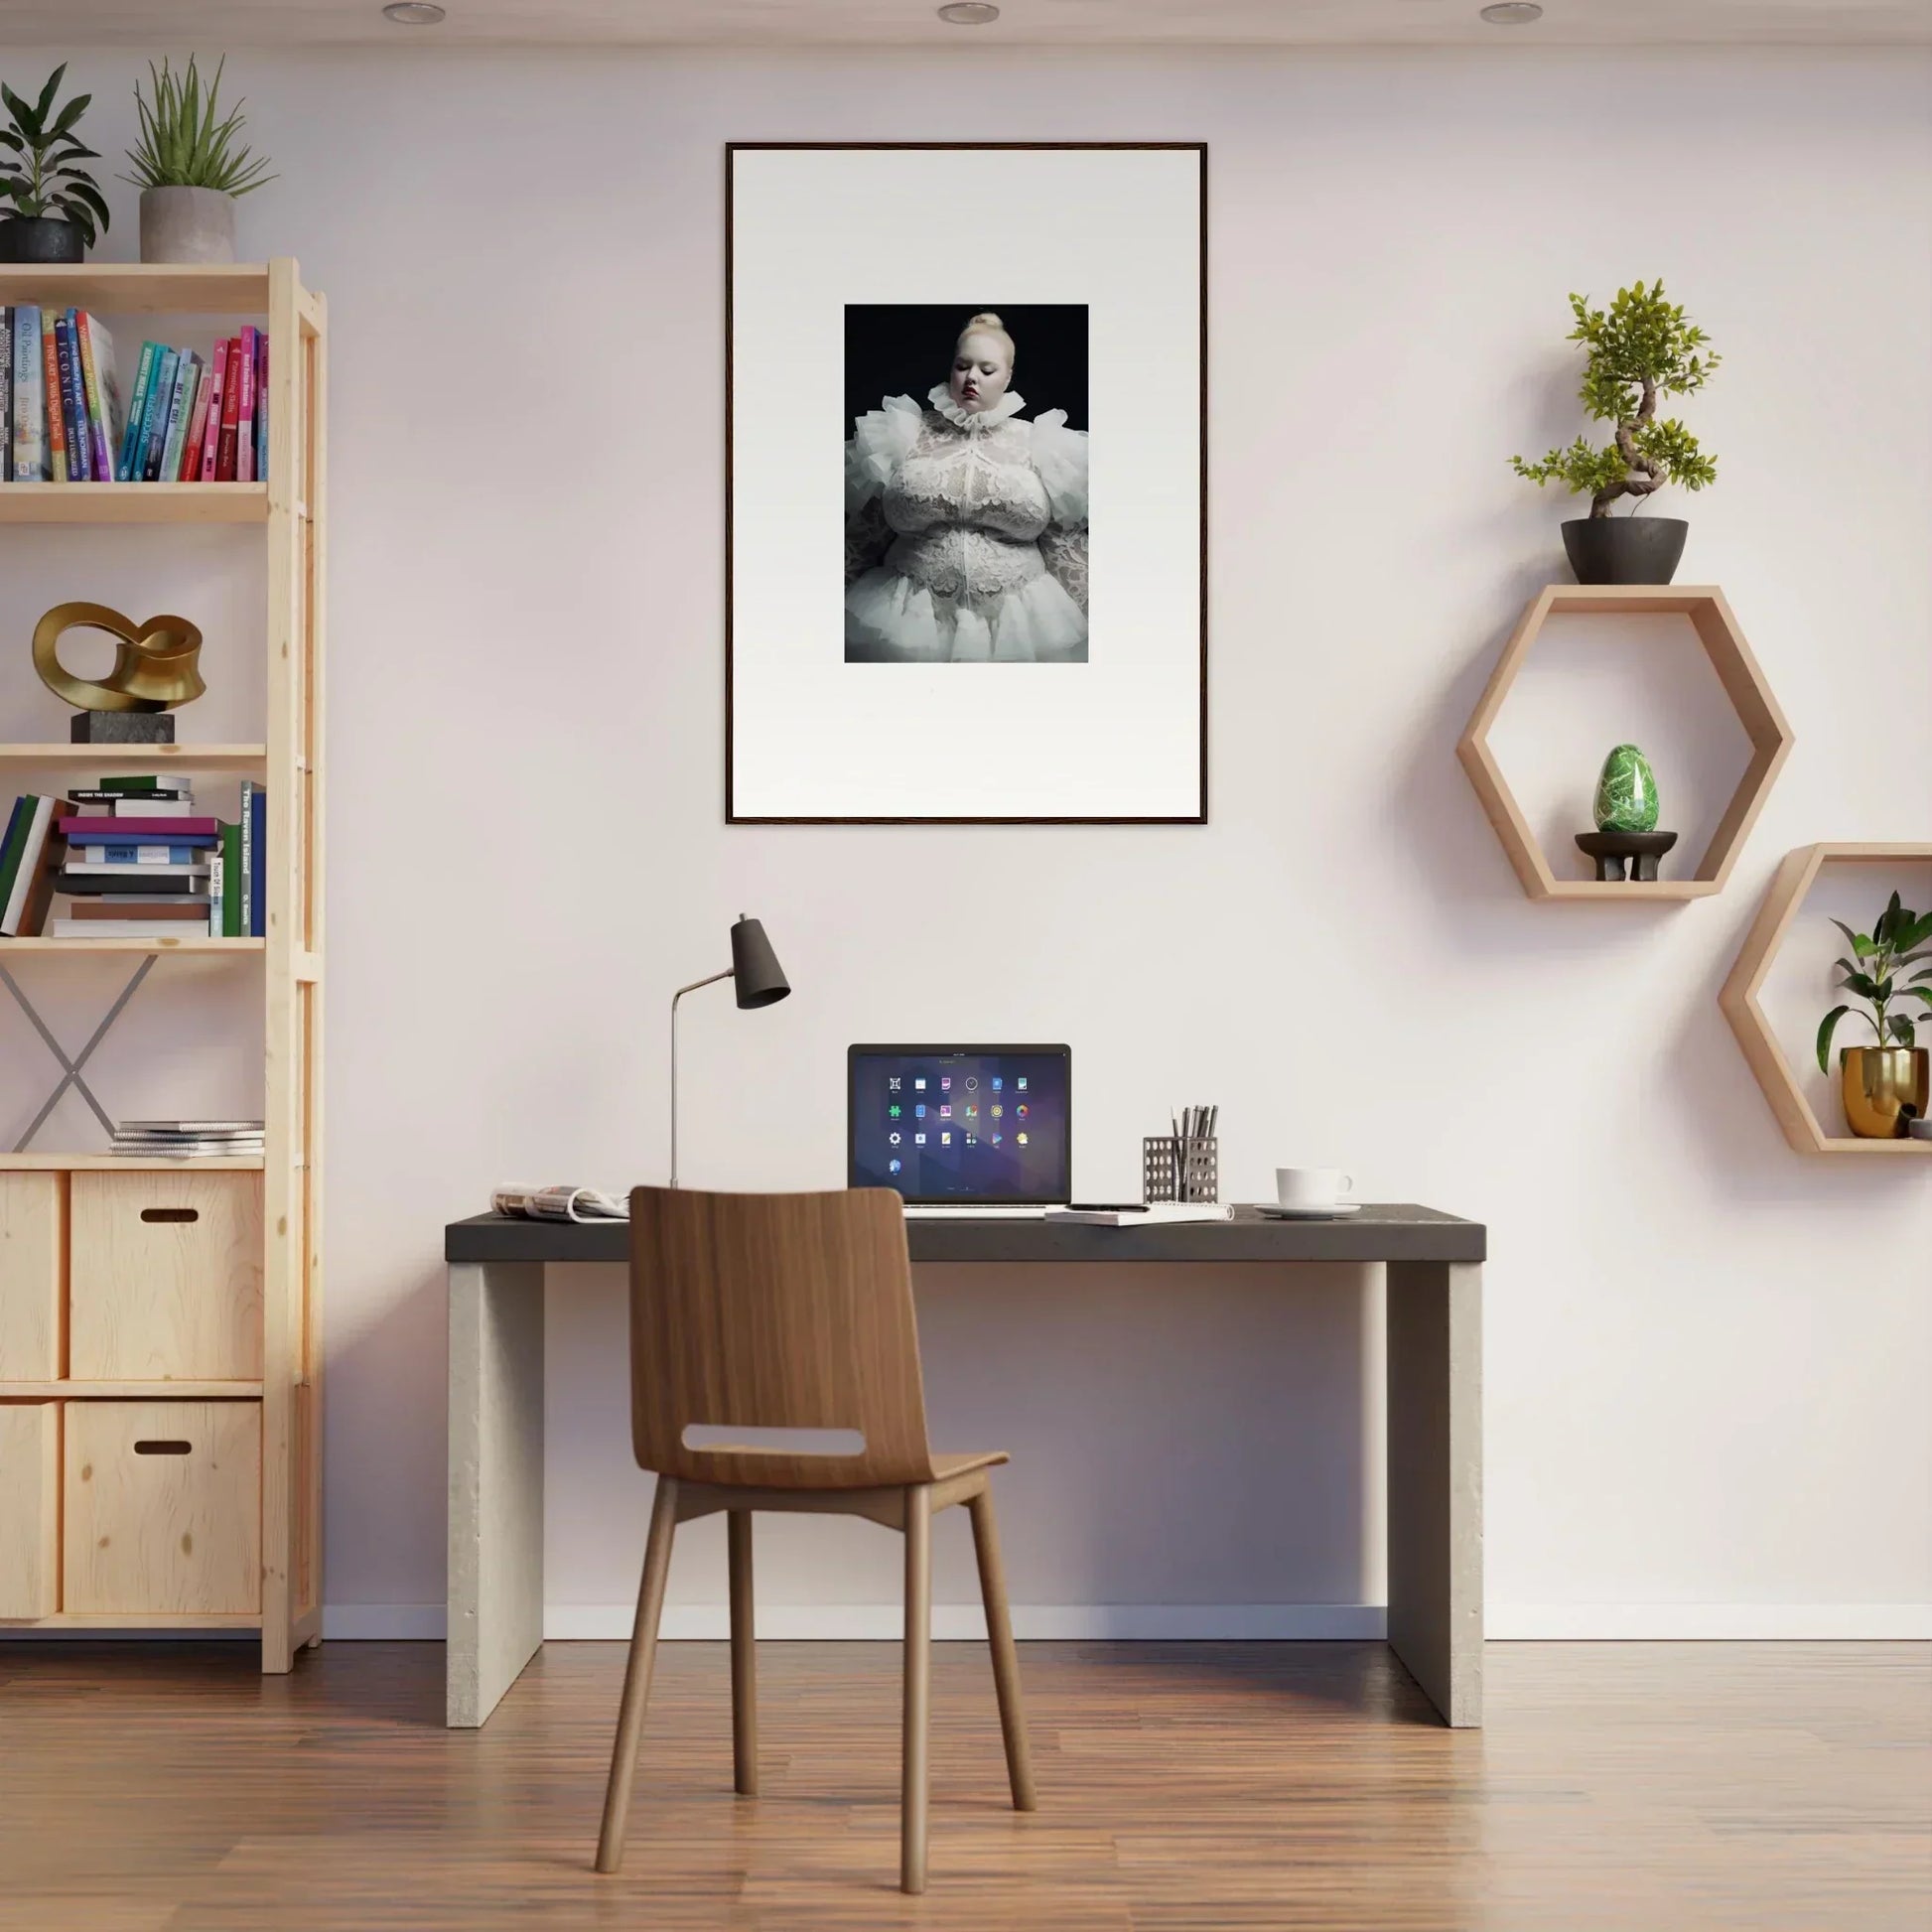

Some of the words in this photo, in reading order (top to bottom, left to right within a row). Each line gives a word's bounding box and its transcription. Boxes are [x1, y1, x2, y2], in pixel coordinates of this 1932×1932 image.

[22, 323, 33, 338] Oil
[19, 341, 33, 382] Paintings
[48, 362, 57, 377] ART
[59, 343, 73, 405] ICONIC
[228, 360, 239, 393] Parenting
[50, 381, 59, 399] With
[49, 399, 60, 421] Digital
[226, 394, 236, 413] Skills
